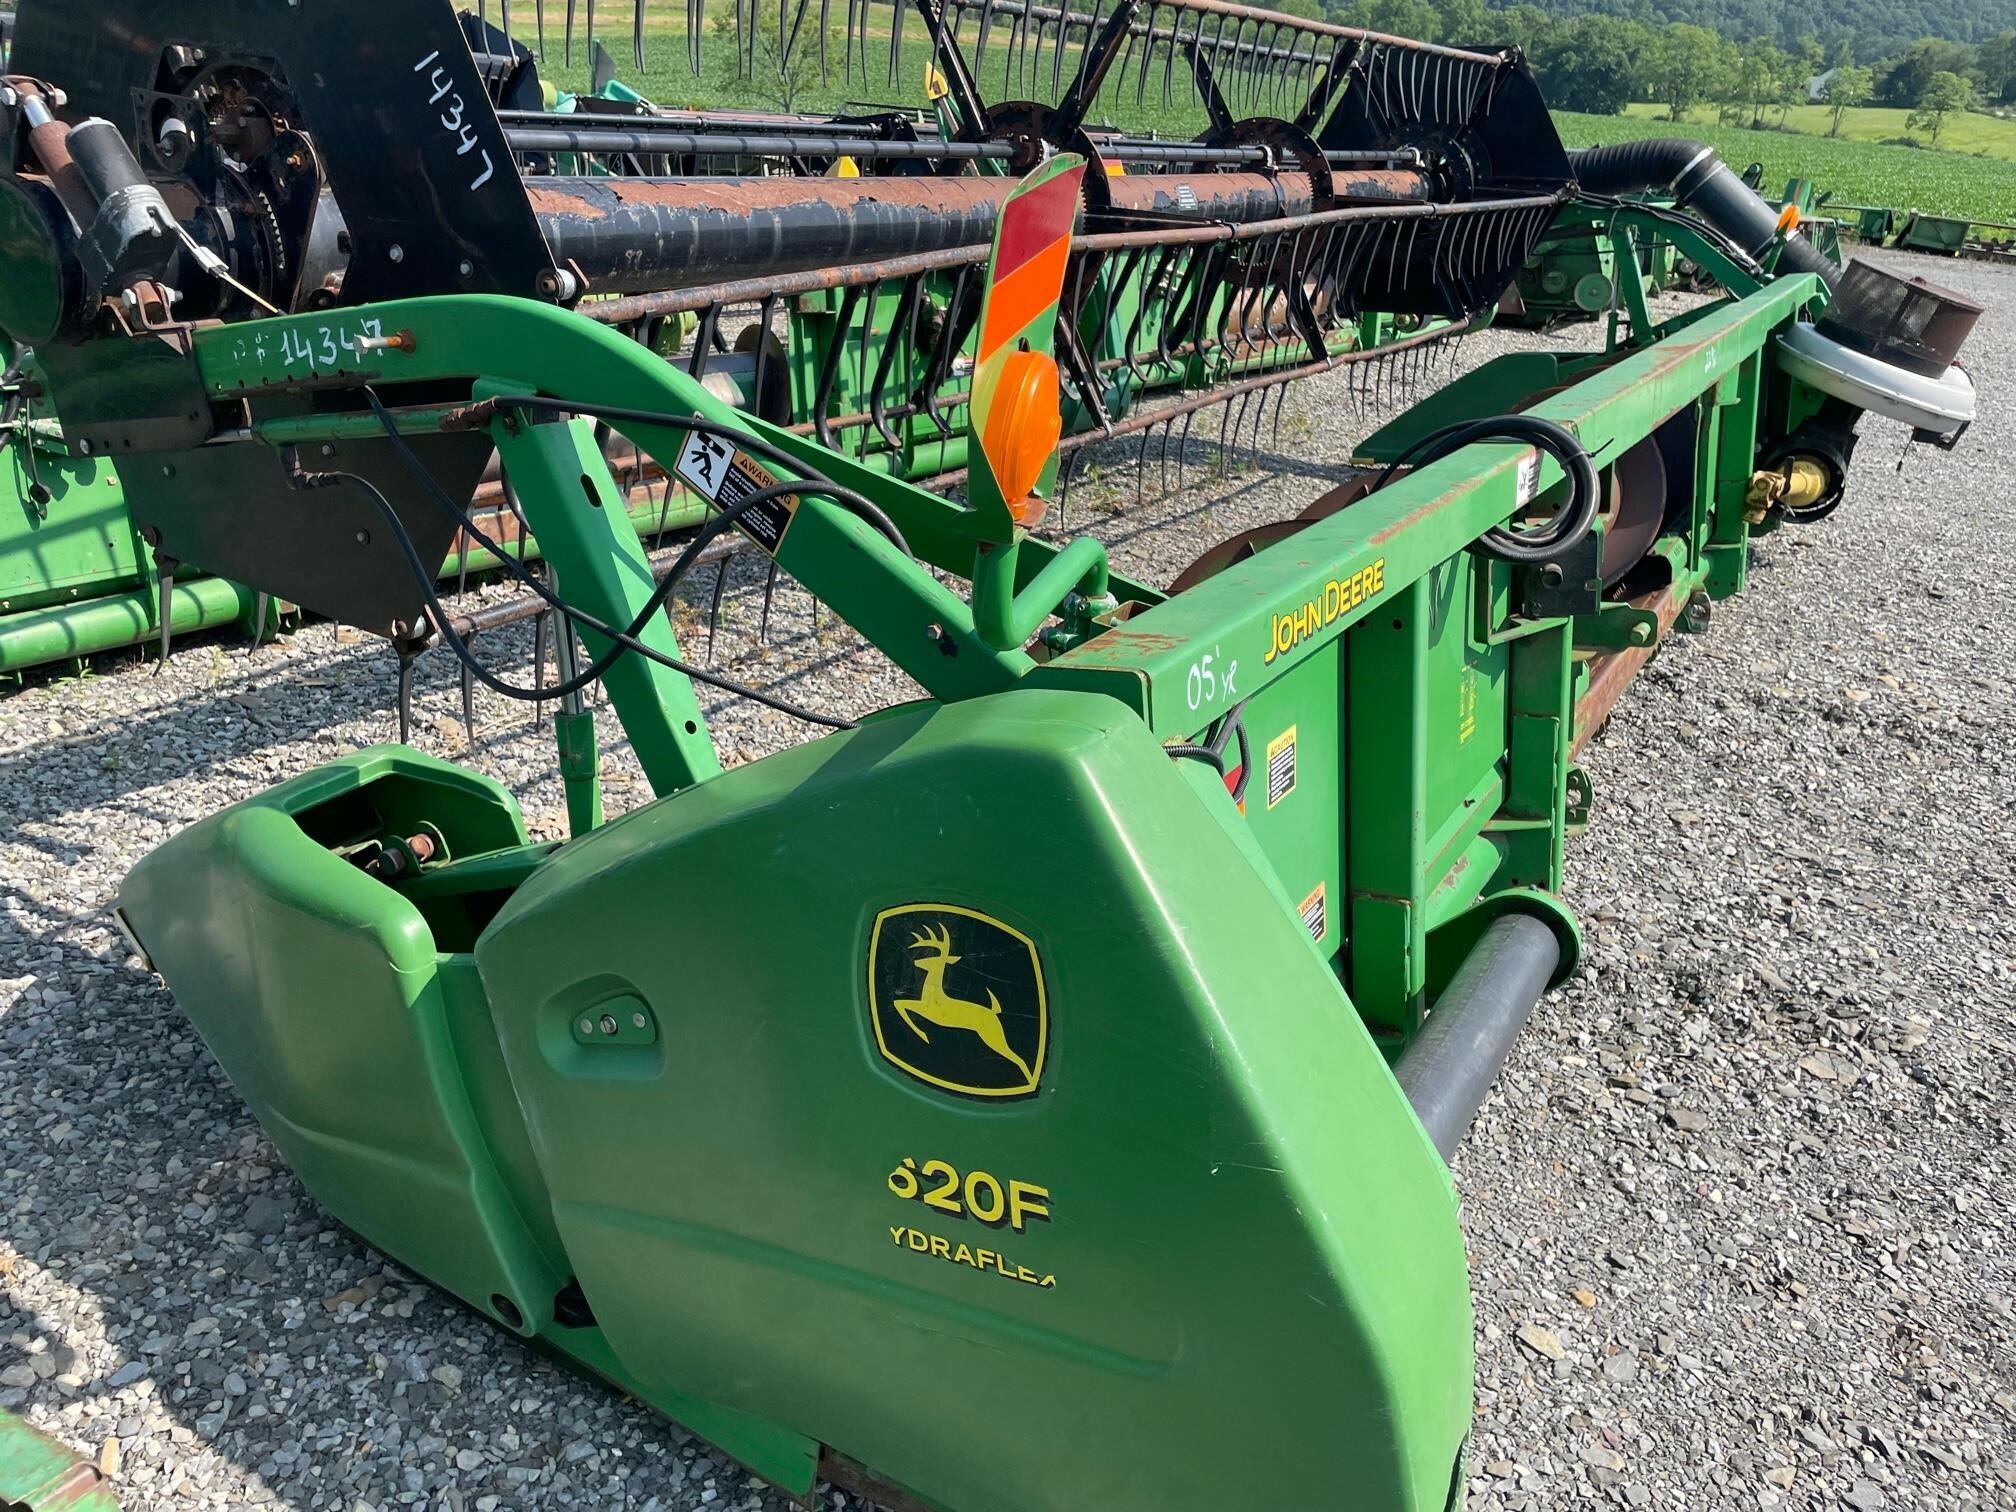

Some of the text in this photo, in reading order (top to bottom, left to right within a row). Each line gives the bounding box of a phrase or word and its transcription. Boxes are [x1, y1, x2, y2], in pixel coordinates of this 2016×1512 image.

[413, 50, 494, 192] 14347
[747, 463, 793, 505] WARG
[1264, 557, 1386, 665] JOHN DEERE
[888, 1157, 1052, 1231] 620F
